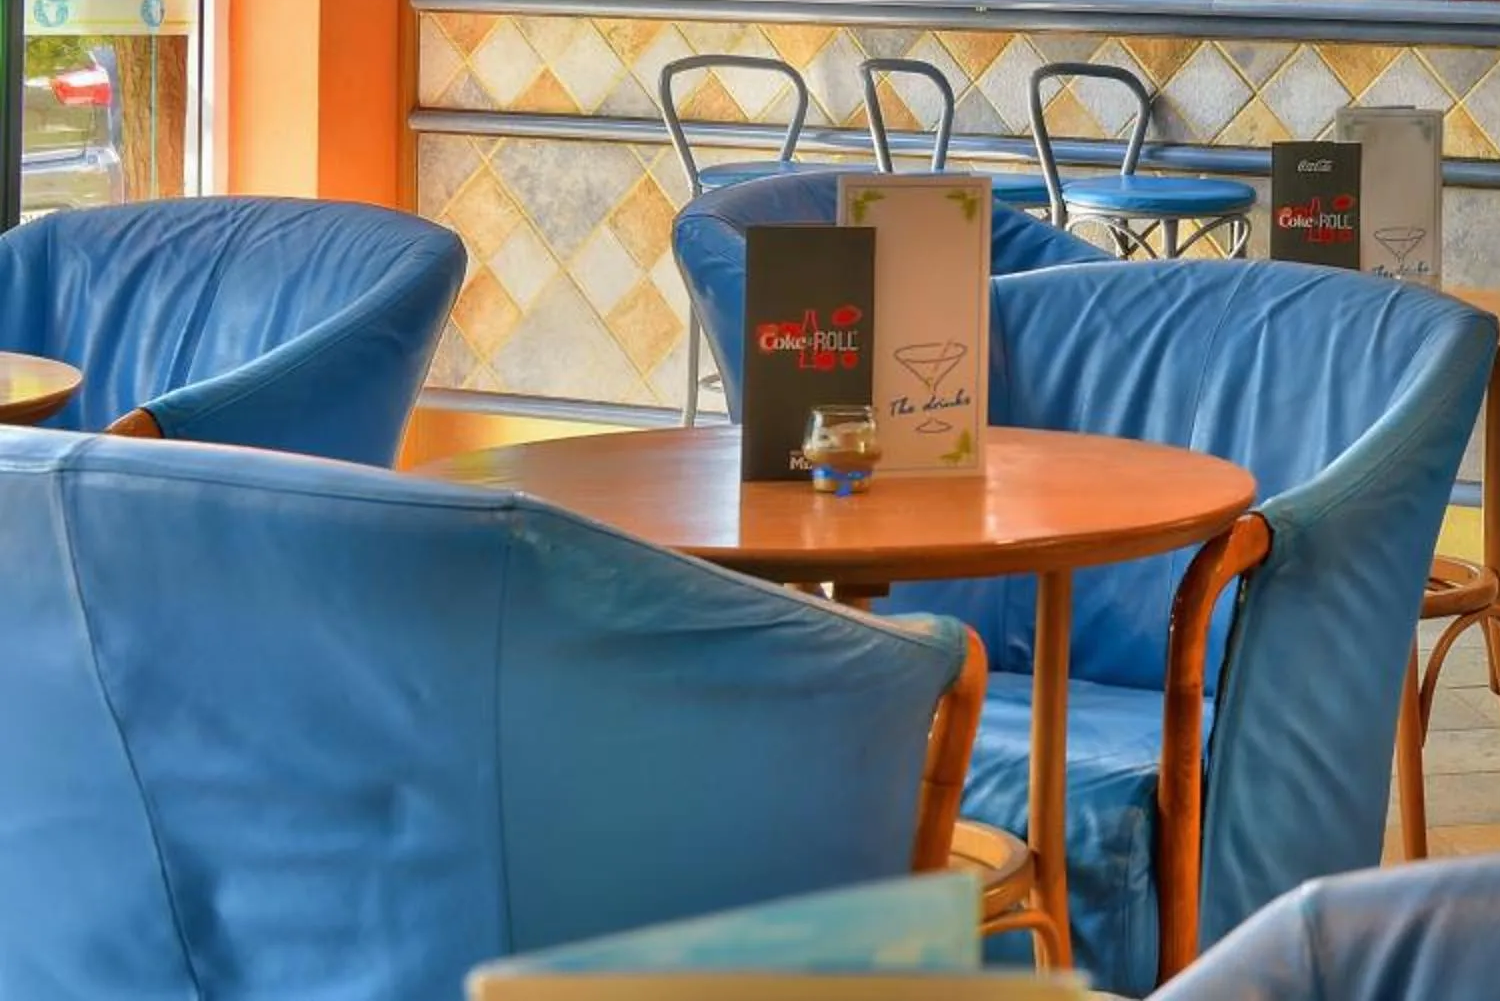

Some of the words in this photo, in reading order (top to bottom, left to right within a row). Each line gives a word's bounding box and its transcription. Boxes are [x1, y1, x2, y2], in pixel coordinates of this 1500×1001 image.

[1279, 214, 1313, 229] Coke
[1319, 214, 1353, 230] ROLL
[761, 332, 807, 350] Coke
[814, 331, 859, 352] ROLL
[890, 397, 916, 417] The
[922, 388, 971, 412] drinks
